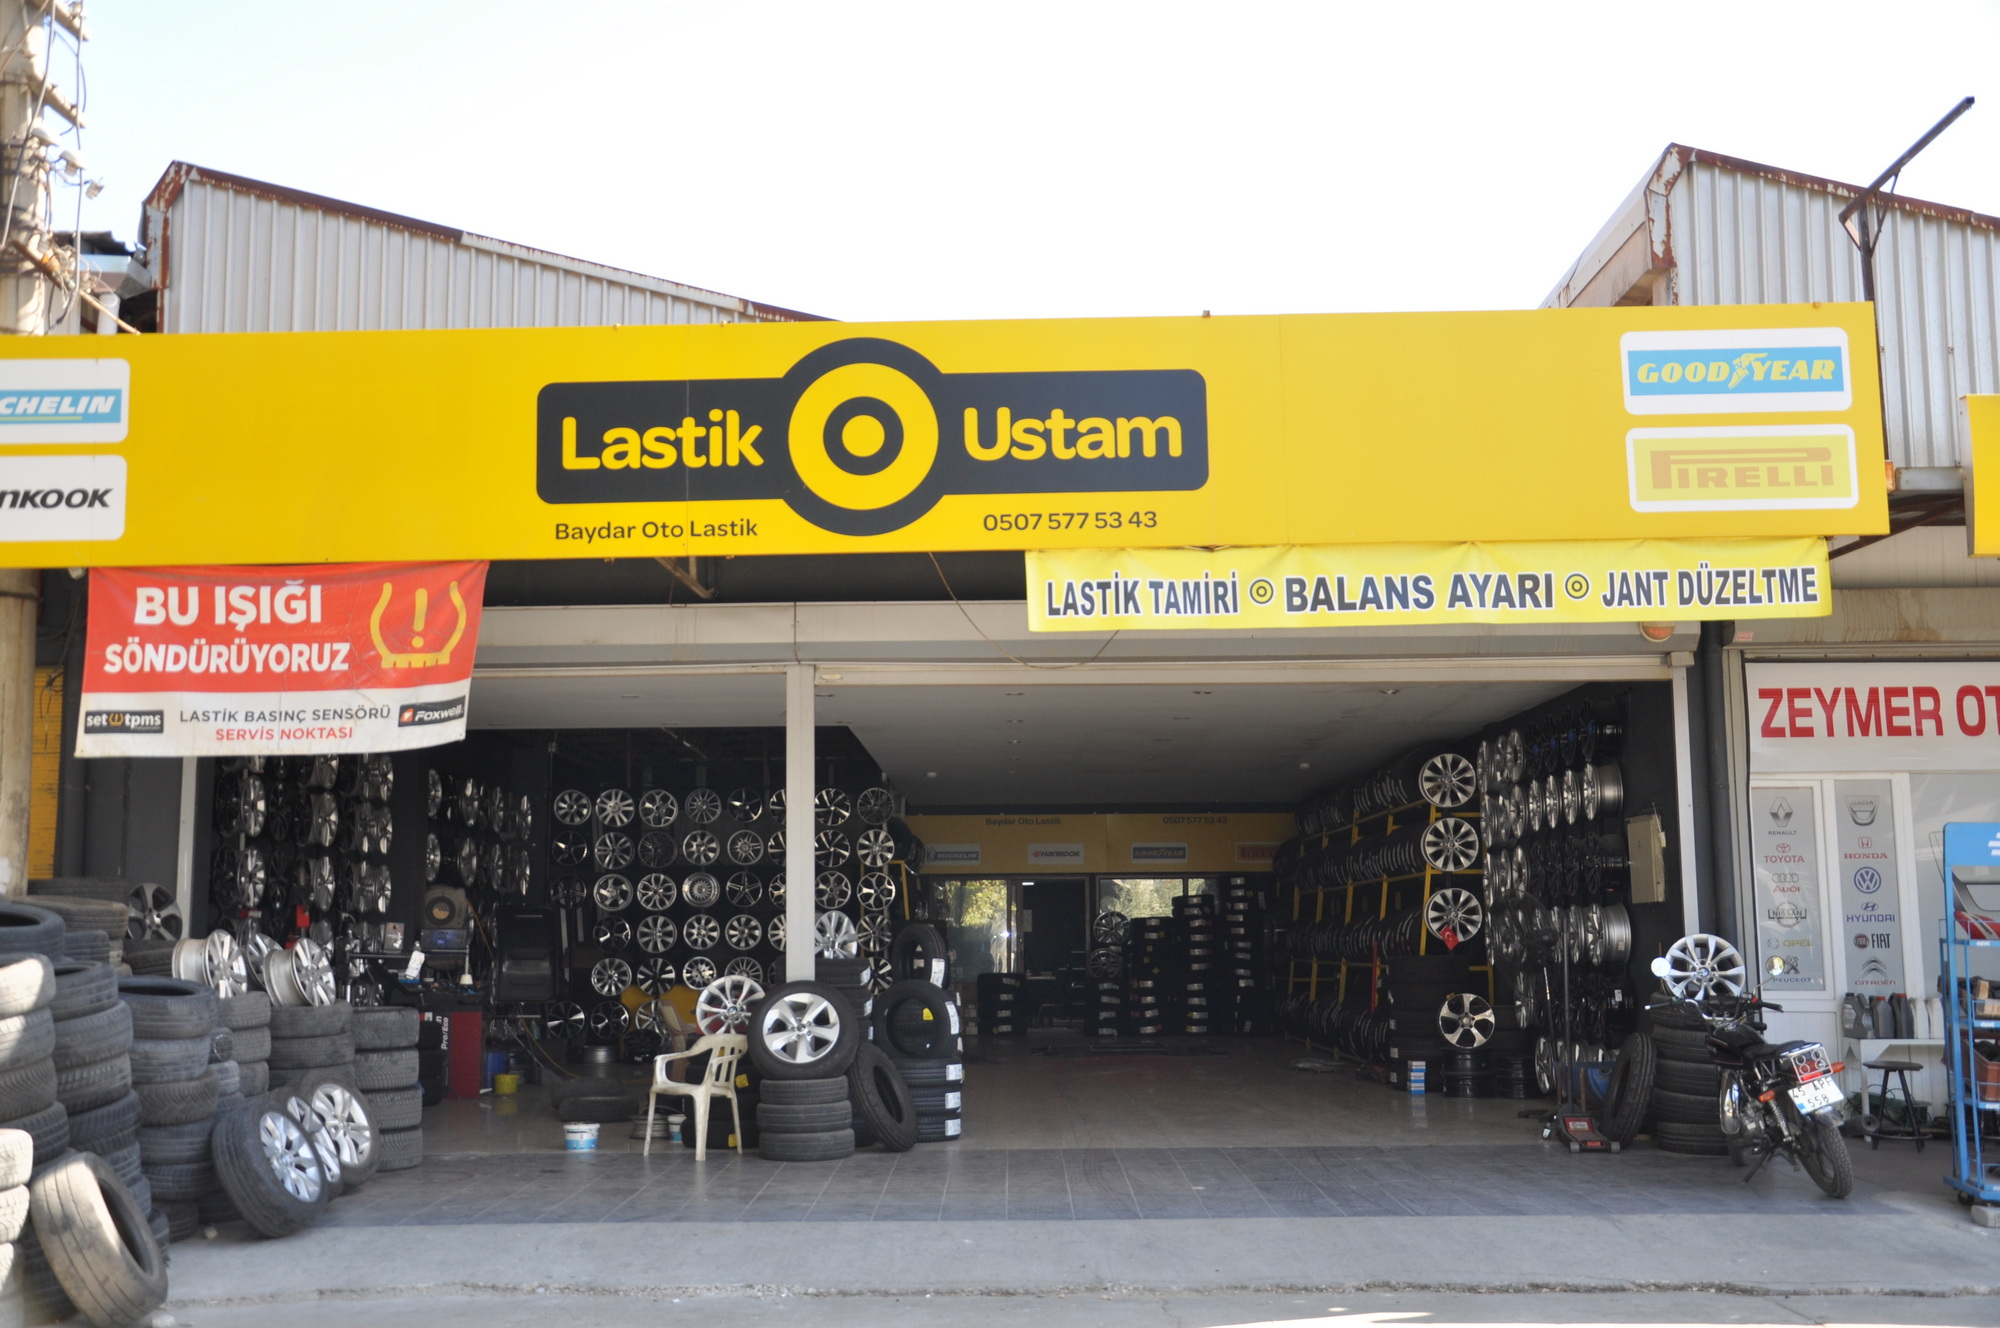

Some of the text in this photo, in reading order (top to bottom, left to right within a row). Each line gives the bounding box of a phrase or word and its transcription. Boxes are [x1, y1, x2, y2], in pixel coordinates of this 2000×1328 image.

[1637, 359, 1836, 384] GOODYEAR
[562, 406, 1182, 470] Lastik Ustam
[1650, 447, 1835, 489] PIRELLI
[555, 518, 758, 544] Baydar Oto Lastik
[983, 511, 1157, 532] 0507 577 53 43
[1047, 562, 1819, 616] LASTİK TAMİRİ BALANS AYARI JANT DÜZELTME
[134, 580, 322, 632] BU IŞIĞI
[104, 636, 351, 674] SÖNDÜRÜYORUZ
[180, 705, 390, 723] LASTİK BASINÇ SENSÖRÜ
[1758, 686, 1944, 738] ZEYMER
[215, 726, 353, 741] SERVİS NOKTASI
[986, 817, 1062, 827] Baydar Oto Lastik
[1764, 855, 1805, 863] TOYOTA
[1846, 914, 1896, 923] HYUNDAI
[1783, 939, 1813, 947] OPEL
[1871, 933, 1891, 949] FIAT
[1807, 1093, 1830, 1108] 558
